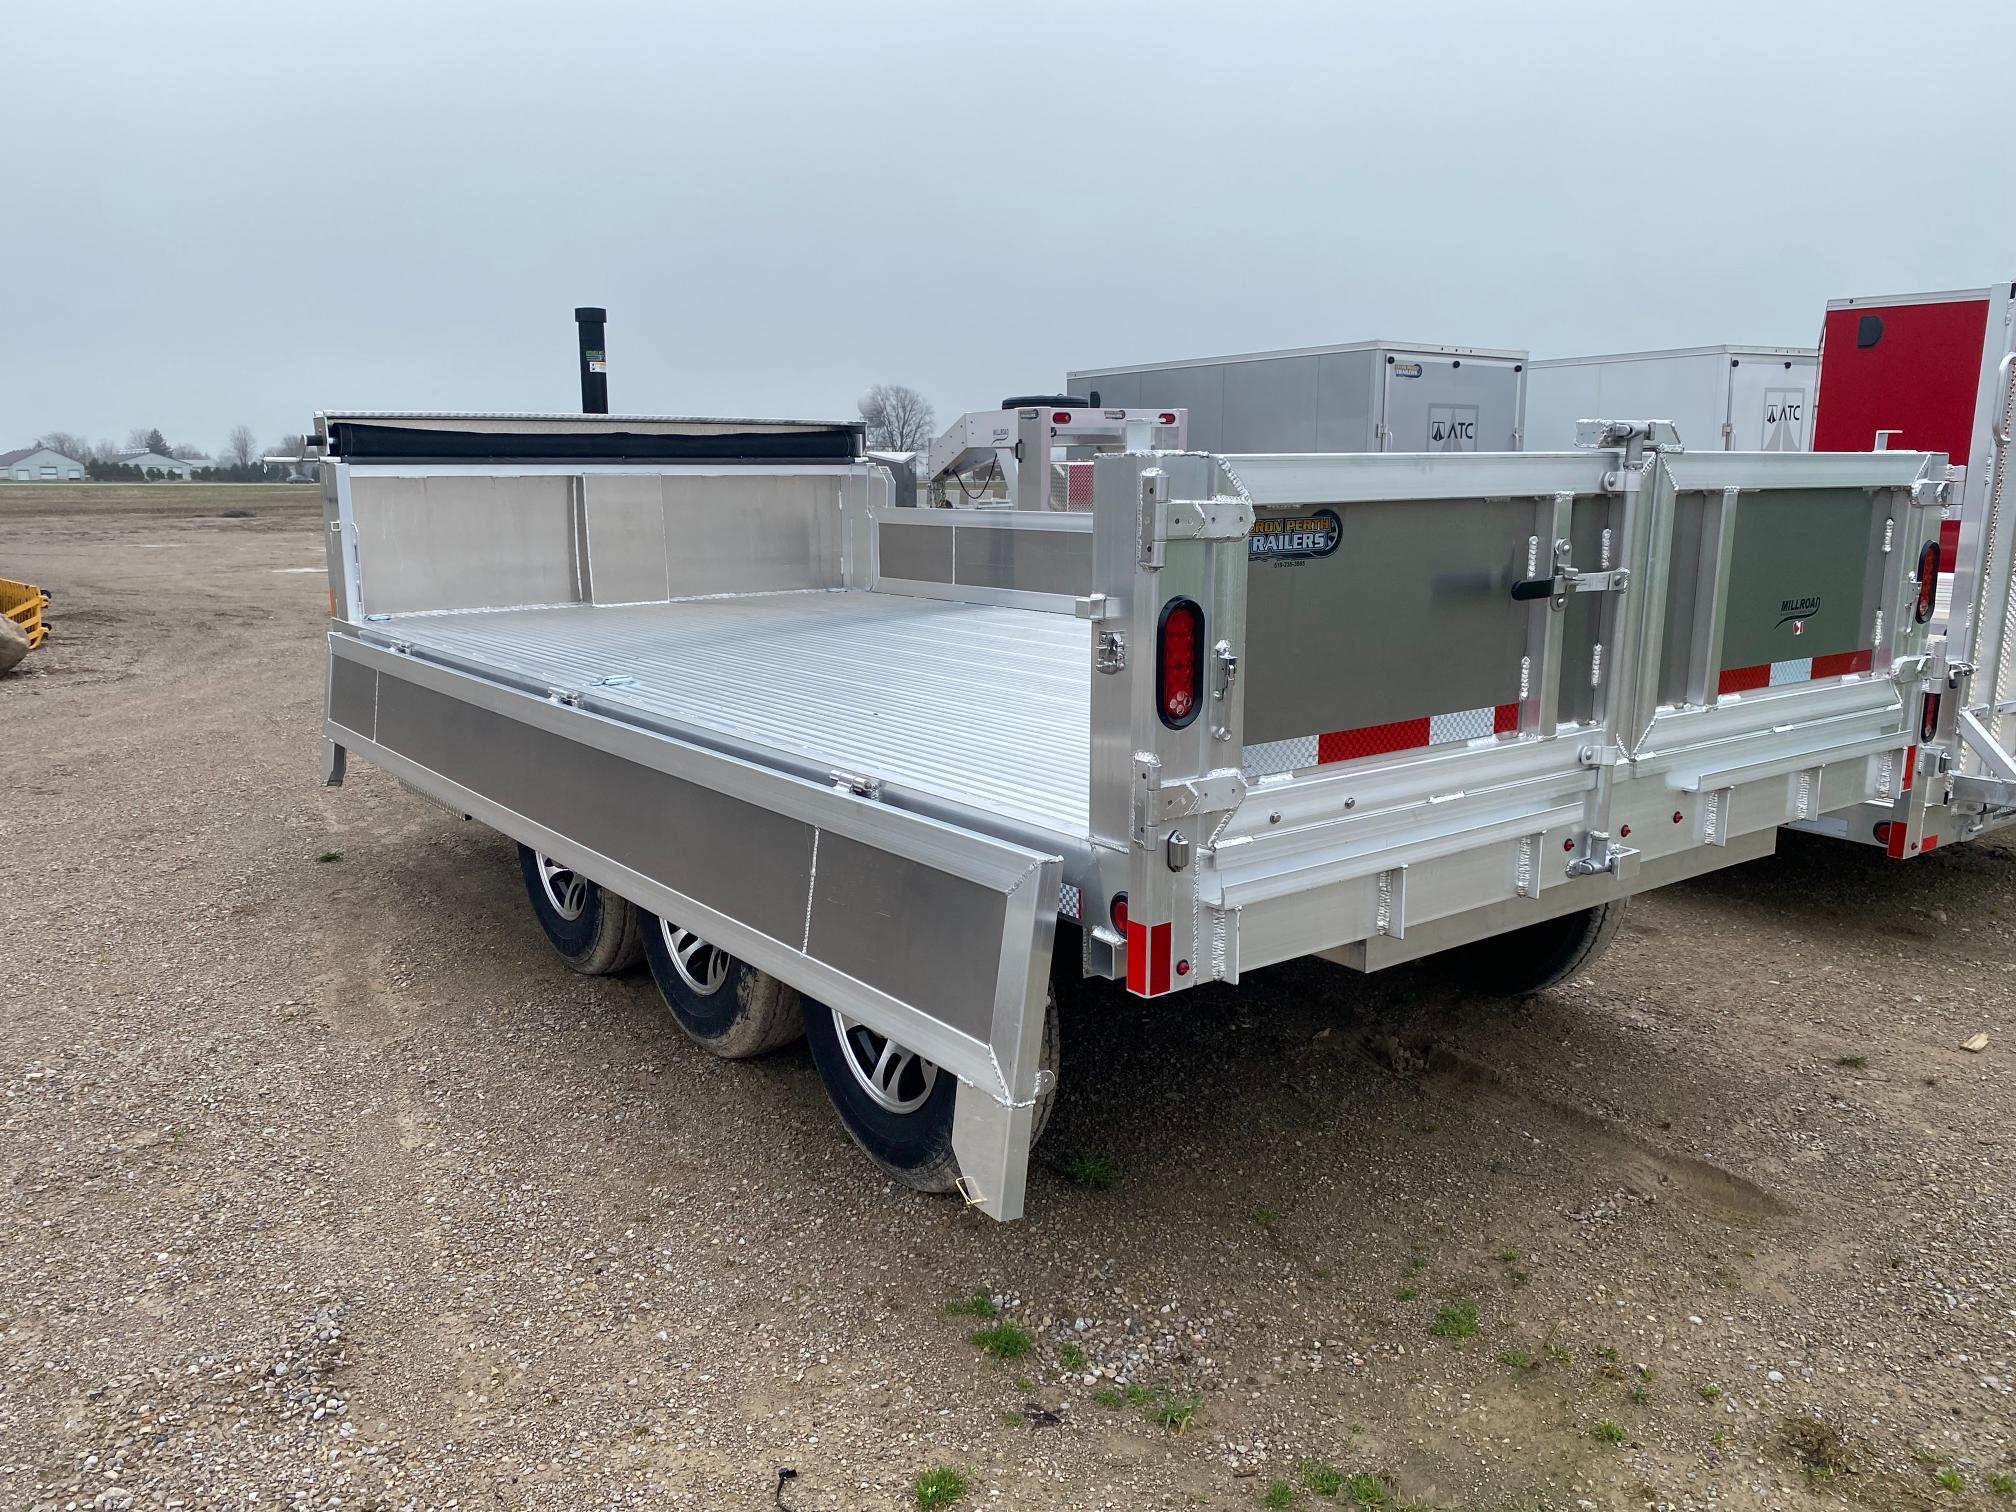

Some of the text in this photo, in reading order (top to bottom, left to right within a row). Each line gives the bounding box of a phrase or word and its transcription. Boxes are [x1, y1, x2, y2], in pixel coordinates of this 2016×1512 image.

[1779, 405, 1800, 421] ATC
[1447, 423, 1473, 439] ATC
[1287, 517, 1330, 531] PERTH
[1781, 596, 1820, 611] MILLROAD
